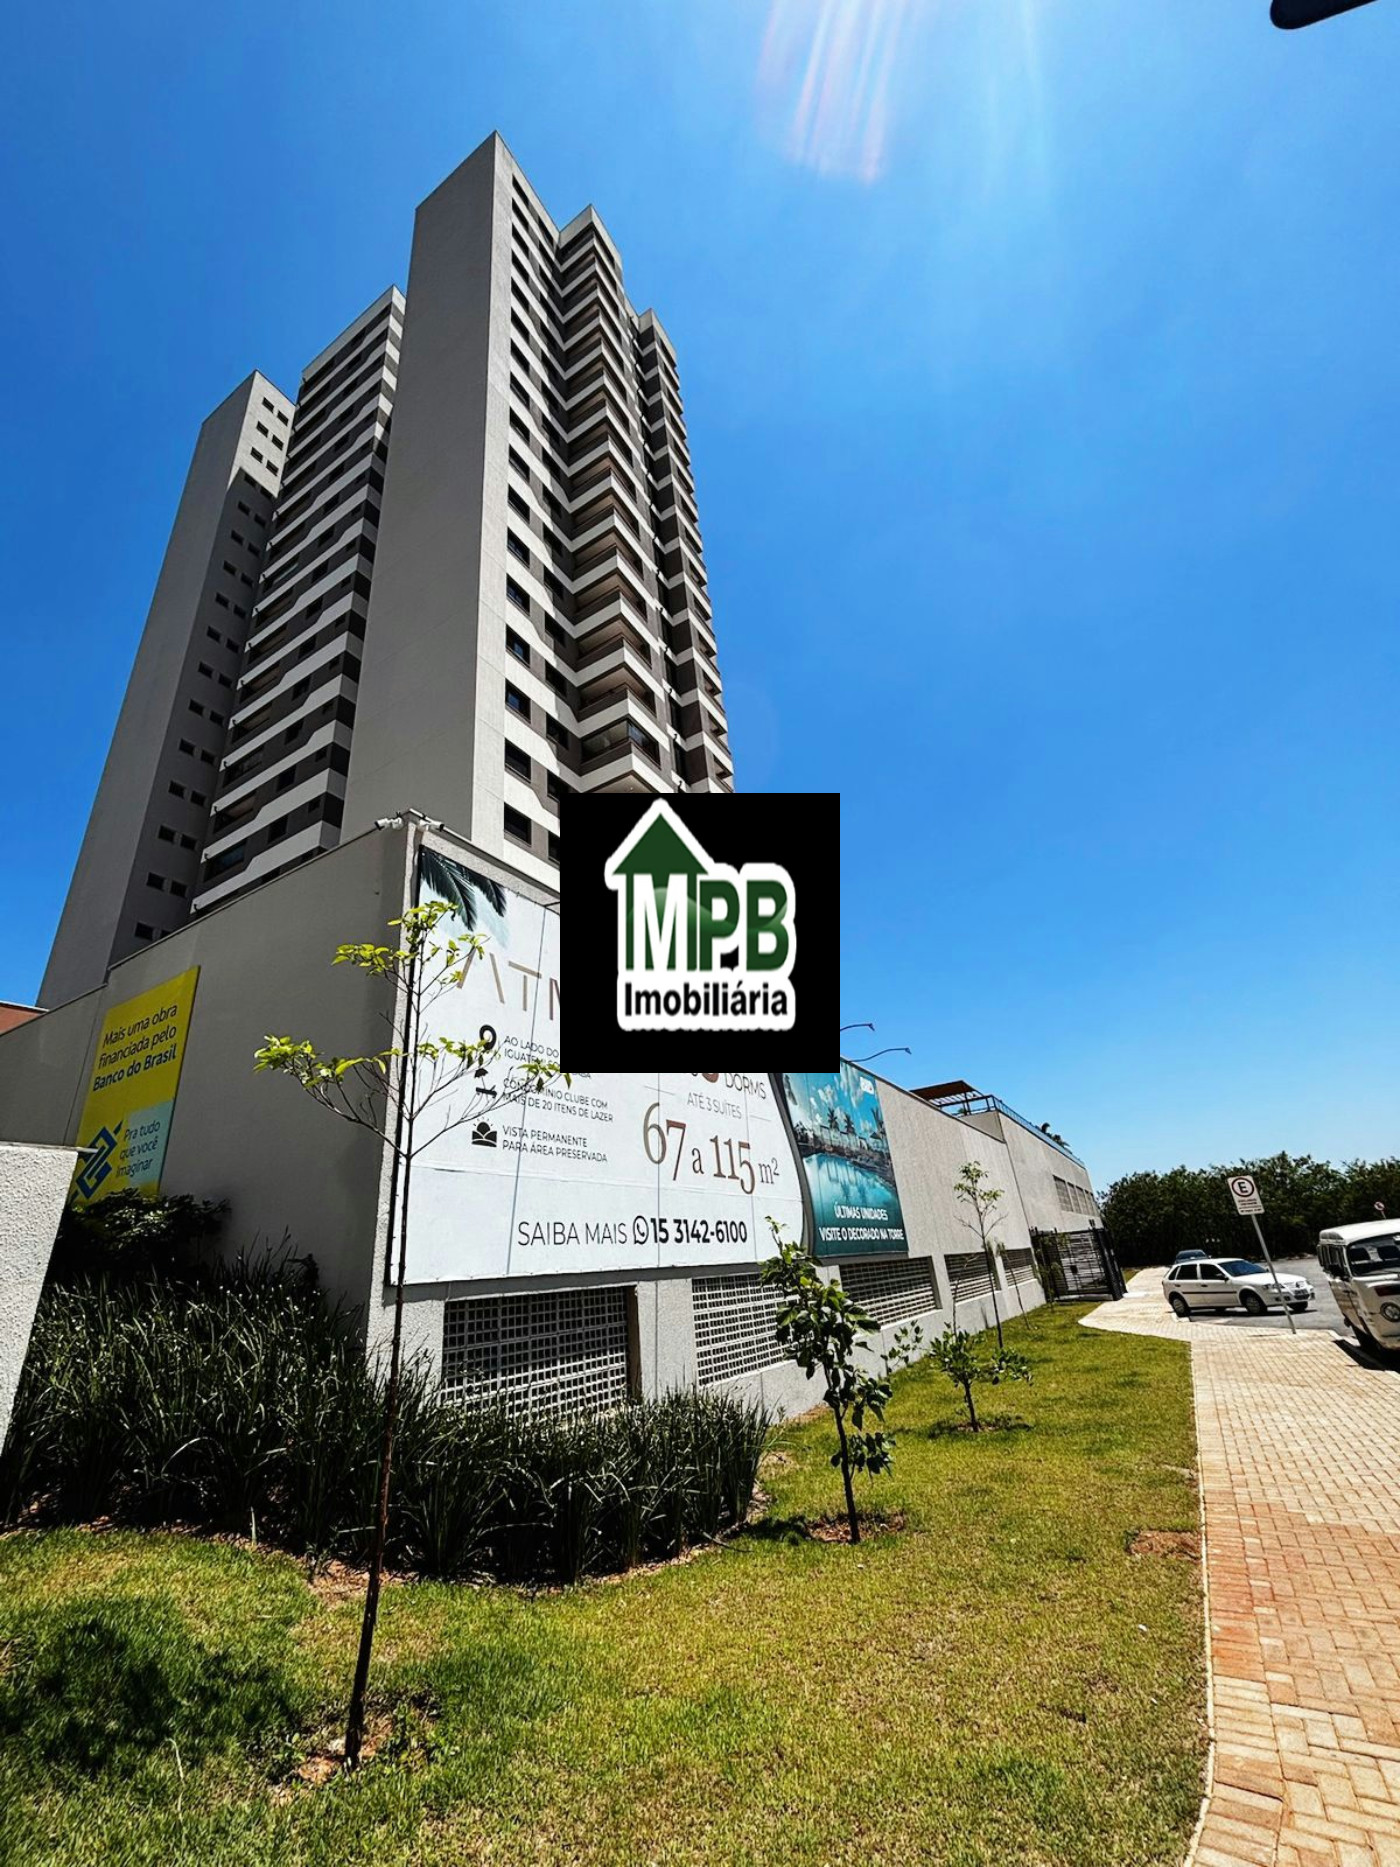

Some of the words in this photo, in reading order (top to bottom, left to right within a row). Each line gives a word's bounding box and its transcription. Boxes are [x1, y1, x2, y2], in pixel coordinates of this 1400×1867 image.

[102, 1027, 126, 1048] Mais
[127, 1017, 150, 1036] uma
[152, 1005, 177, 1024] obra
[98, 1036, 150, 1069] financiada
[151, 1024, 177, 1050] pelo
[503, 1035, 519, 1047] AO
[520, 1040, 544, 1055] LADO
[546, 1047, 560, 1058] DO
[93, 1069, 124, 1092] Banco
[127, 1060, 141, 1077] do
[143, 1043, 177, 1071] Brasil
[725, 1073, 767, 1100] DORMS
[528, 1097, 540, 1109] DE
[542, 1101, 553, 1111] 20
[554, 1103, 577, 1116] ITENS
[579, 1108, 589, 1119] DE
[591, 1111, 613, 1122] LAZER
[564, 1092, 589, 1106] CLUBE
[591, 1098, 608, 1109] COM
[687, 1092, 704, 1110] ATÉ
[705, 1096, 712, 1112] 3
[714, 1098, 742, 1119] SUÍTES
[124, 1128, 138, 1141] Pra
[140, 1120, 161, 1136] tudo
[502, 1125, 529, 1139] VISTA
[530, 1130, 588, 1147] PERMANENTE
[120, 1146, 136, 1160] que
[138, 1136, 158, 1153] você
[502, 1139, 528, 1153] PARA
[530, 1141, 554, 1156] ÁREA
[556, 1147, 608, 1162] PRESERVADA
[643, 1102, 686, 1181] 67
[691, 1147, 704, 1175] a
[709, 1135, 756, 1194] 115
[1237, 1181, 1249, 1194] E
[834, 1201, 860, 1219] ÚLTIMAS
[860, 1207, 888, 1221] UNIDADES
[517, 1221, 580, 1246] SAIBA
[585, 1222, 628, 1245] MAIS
[650, 1217, 669, 1244] 15
[674, 1219, 748, 1244] 3142-6100
[819, 1227, 842, 1241] VISITE
[841, 1227, 848, 1241] O
[847, 1227, 880, 1240] DECORADO
[879, 1228, 889, 1240] NA
[887, 1228, 904, 1240] TORRE
